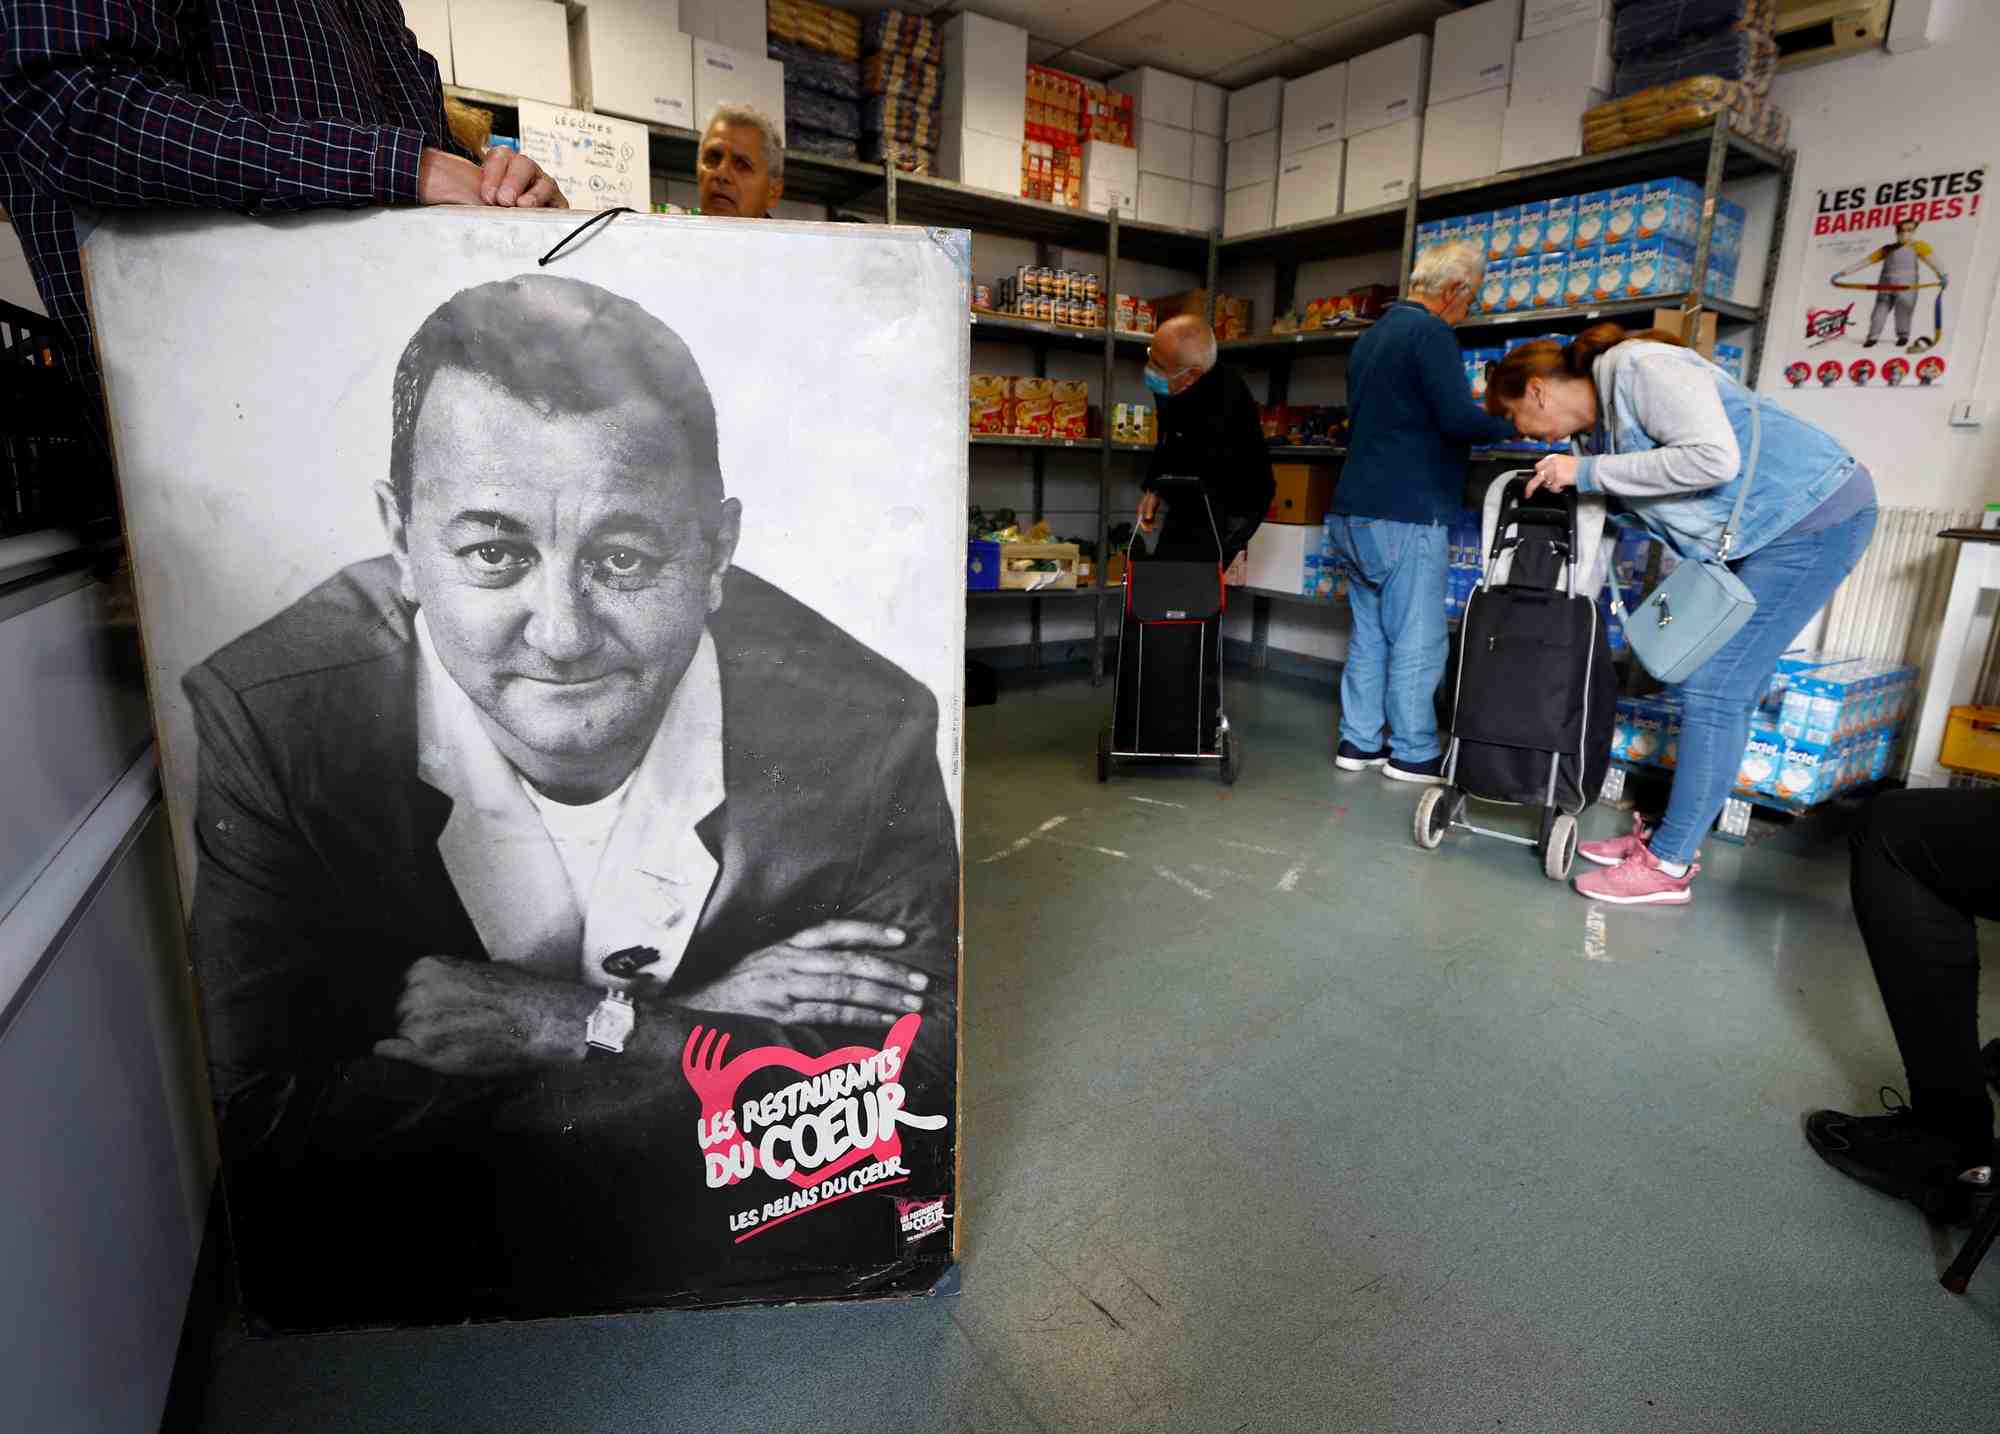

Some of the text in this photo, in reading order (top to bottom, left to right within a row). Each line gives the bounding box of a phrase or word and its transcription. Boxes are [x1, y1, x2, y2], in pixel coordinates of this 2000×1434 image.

[1818, 169, 1985, 214] LES GESTES
[697, 1045, 902, 1150] LES RESTAURANTS
[705, 1140, 755, 1189] DU
[729, 1209, 760, 1232] LES
[761, 1186, 820, 1222] RELAIS
[821, 1177, 847, 1199] DU
